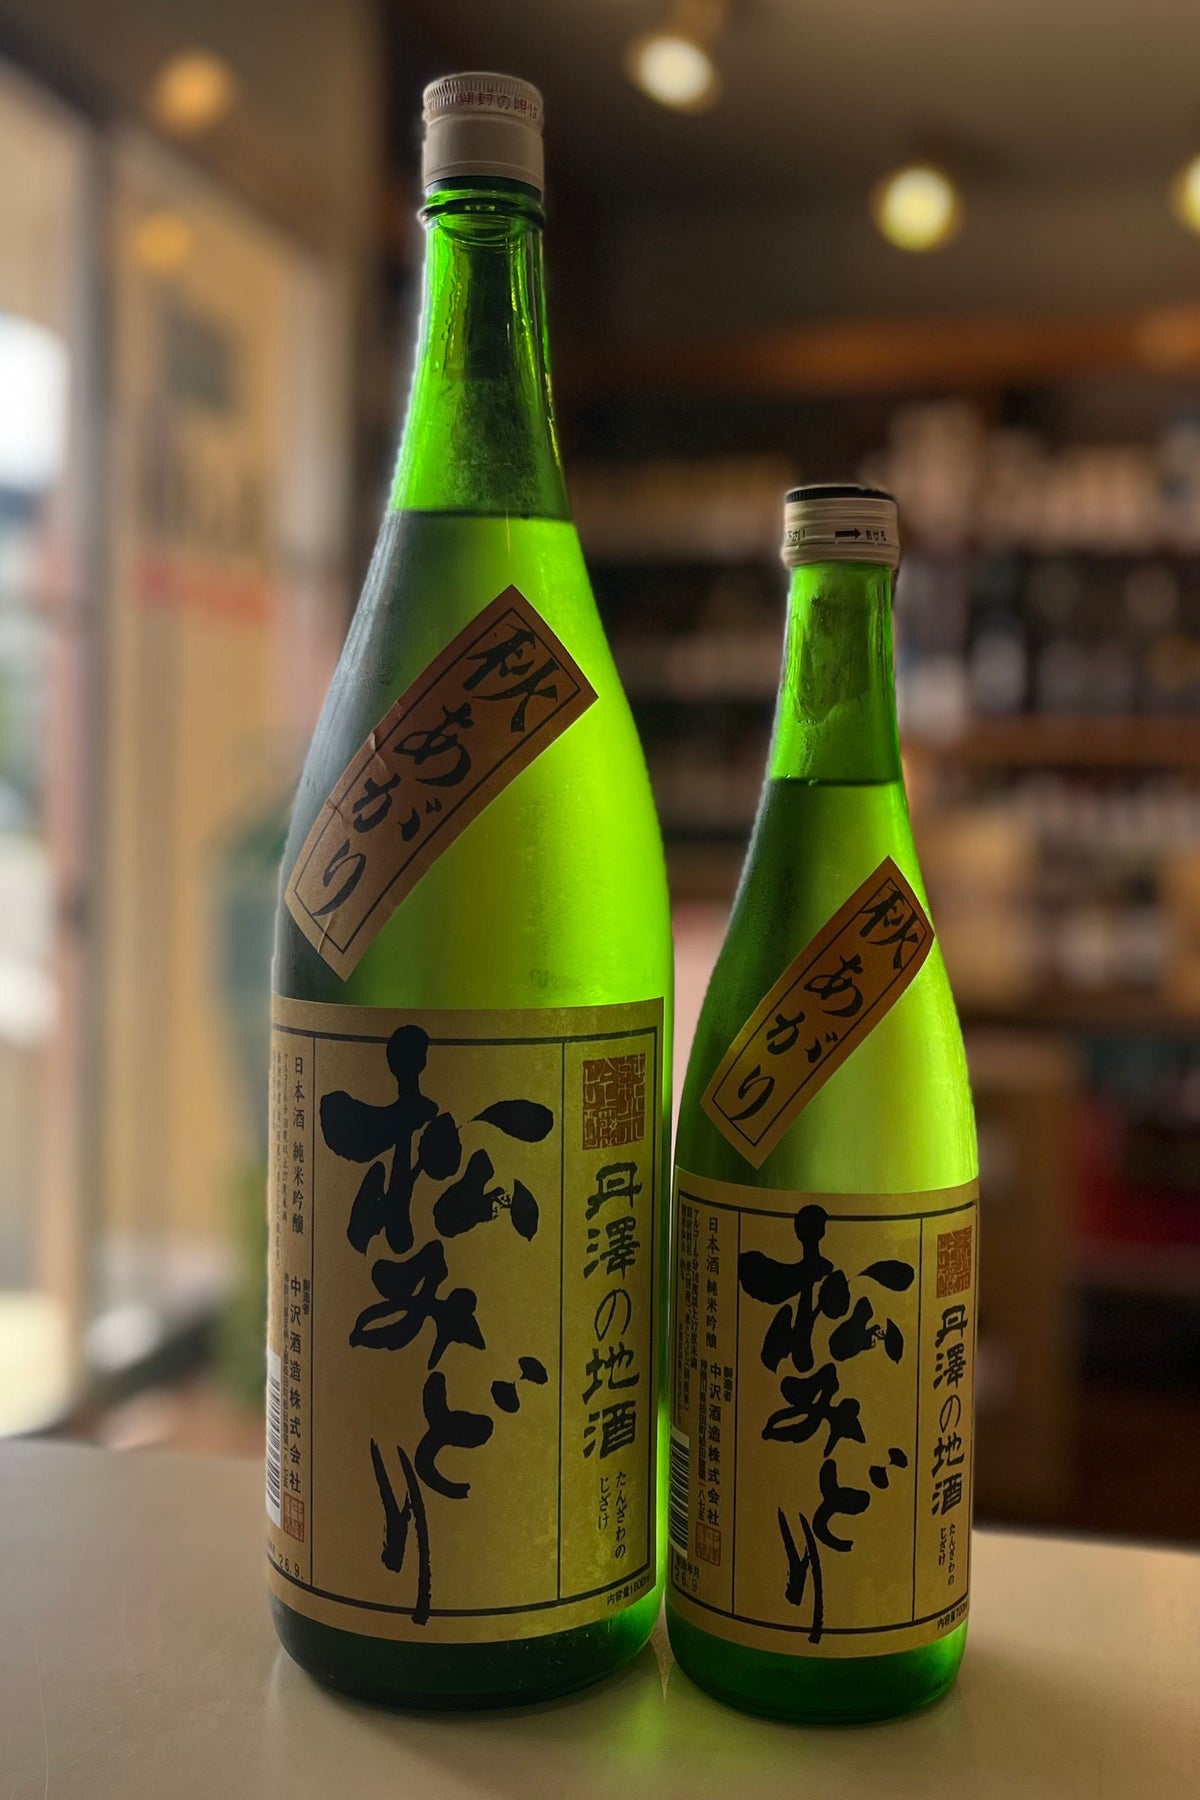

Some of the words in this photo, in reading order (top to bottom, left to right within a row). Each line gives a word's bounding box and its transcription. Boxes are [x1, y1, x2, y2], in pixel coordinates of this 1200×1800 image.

[311, 623, 560, 917] 秋あがり
[729, 886, 919, 1121] 秋あがり
[320, 1025, 553, 1625] 松みどり
[583, 1161, 643, 1459] 丹澤の地酒
[706, 1217, 720, 1275] 日本酒
[289, 1276, 302, 1494] 中沢酒造株式会社
[708, 1362, 721, 1526] 中沢酒造株式会社
[738, 1205, 915, 1644] 松みどり
[932, 1304, 968, 1516] 丹澤の地酒
[598, 1477, 611, 1530] じざけ
[615, 1471, 627, 1559] たんざわの
[938, 1527, 947, 1566] じざけ
[947, 1523, 956, 1586] たんざわの
